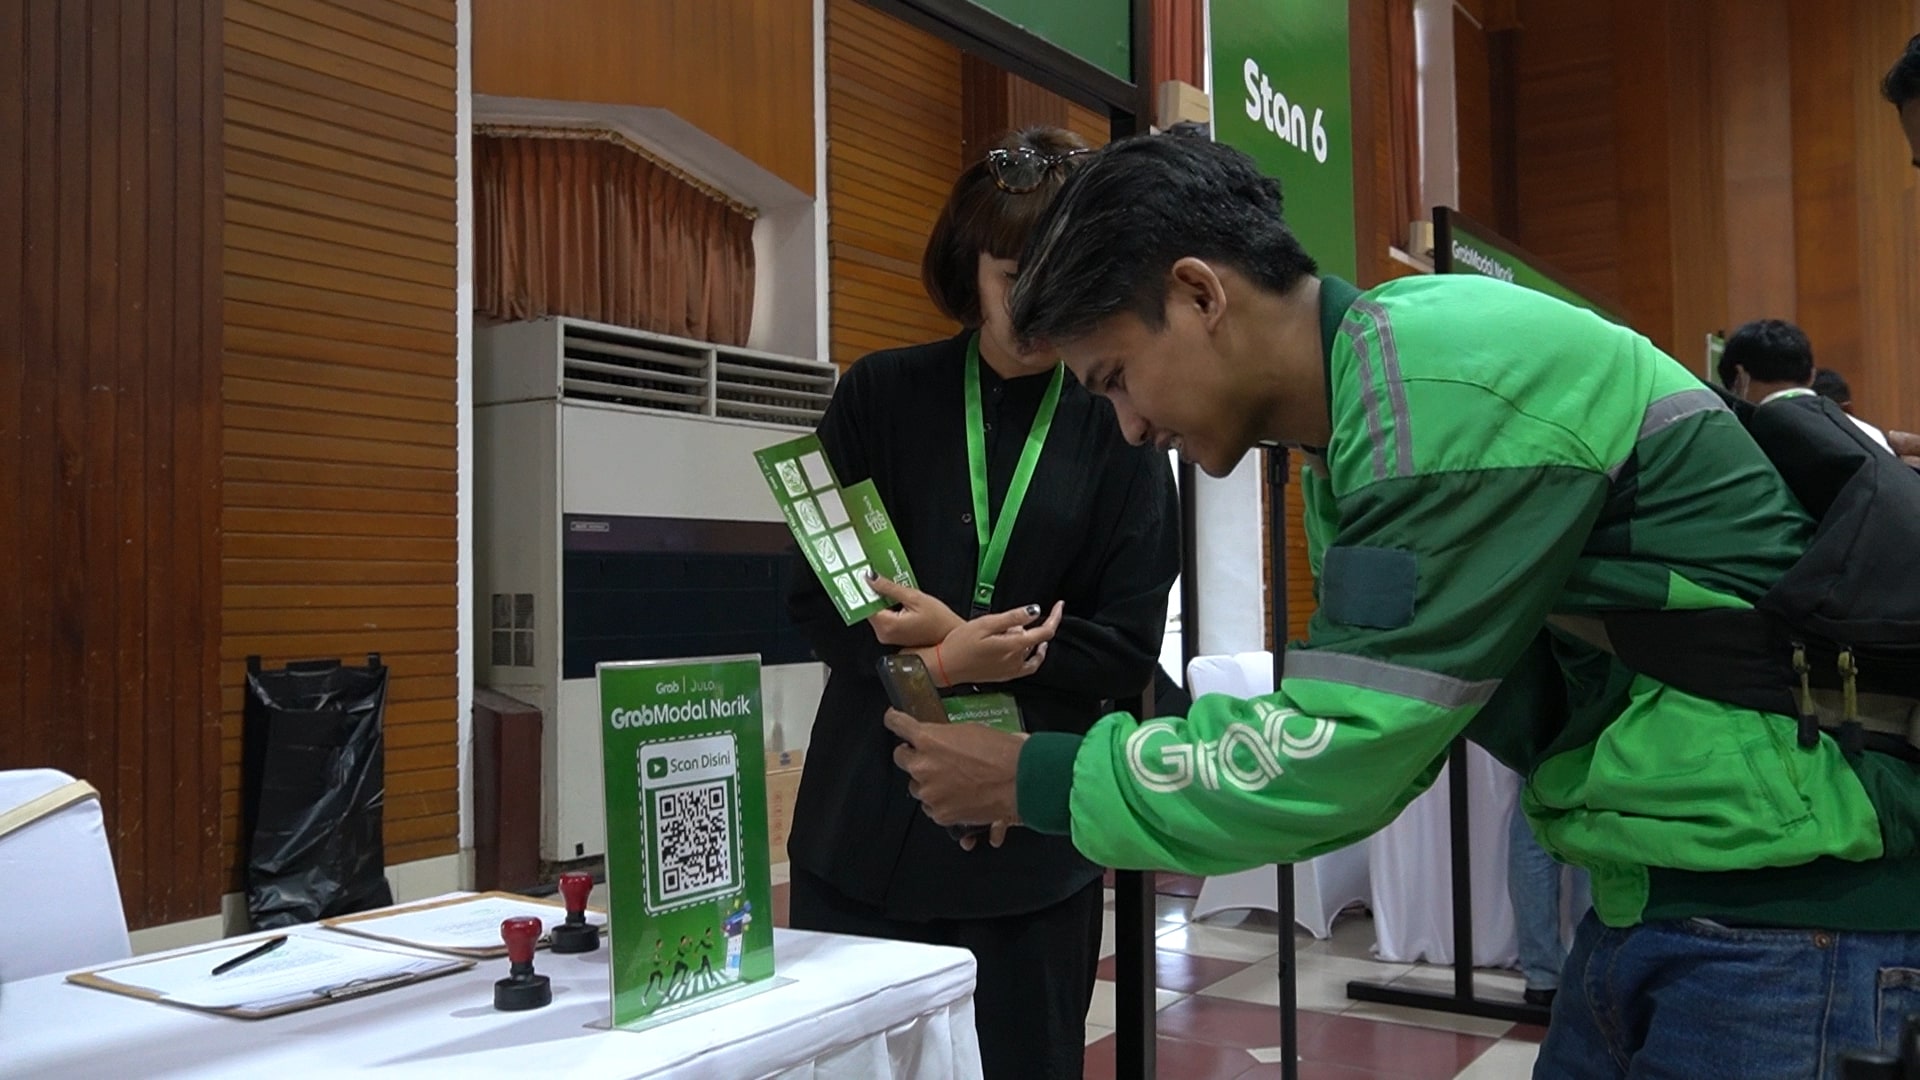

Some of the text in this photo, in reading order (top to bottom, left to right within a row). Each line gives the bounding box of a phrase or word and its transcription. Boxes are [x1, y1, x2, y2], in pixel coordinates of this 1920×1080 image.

[1243, 57, 1328, 164] Stan 6
[655, 680, 680, 695] Grab
[610, 693, 752, 730] GrabModal Narik
[670, 750, 731, 774] Scan Disini
[1125, 701, 1337, 793] Grab
